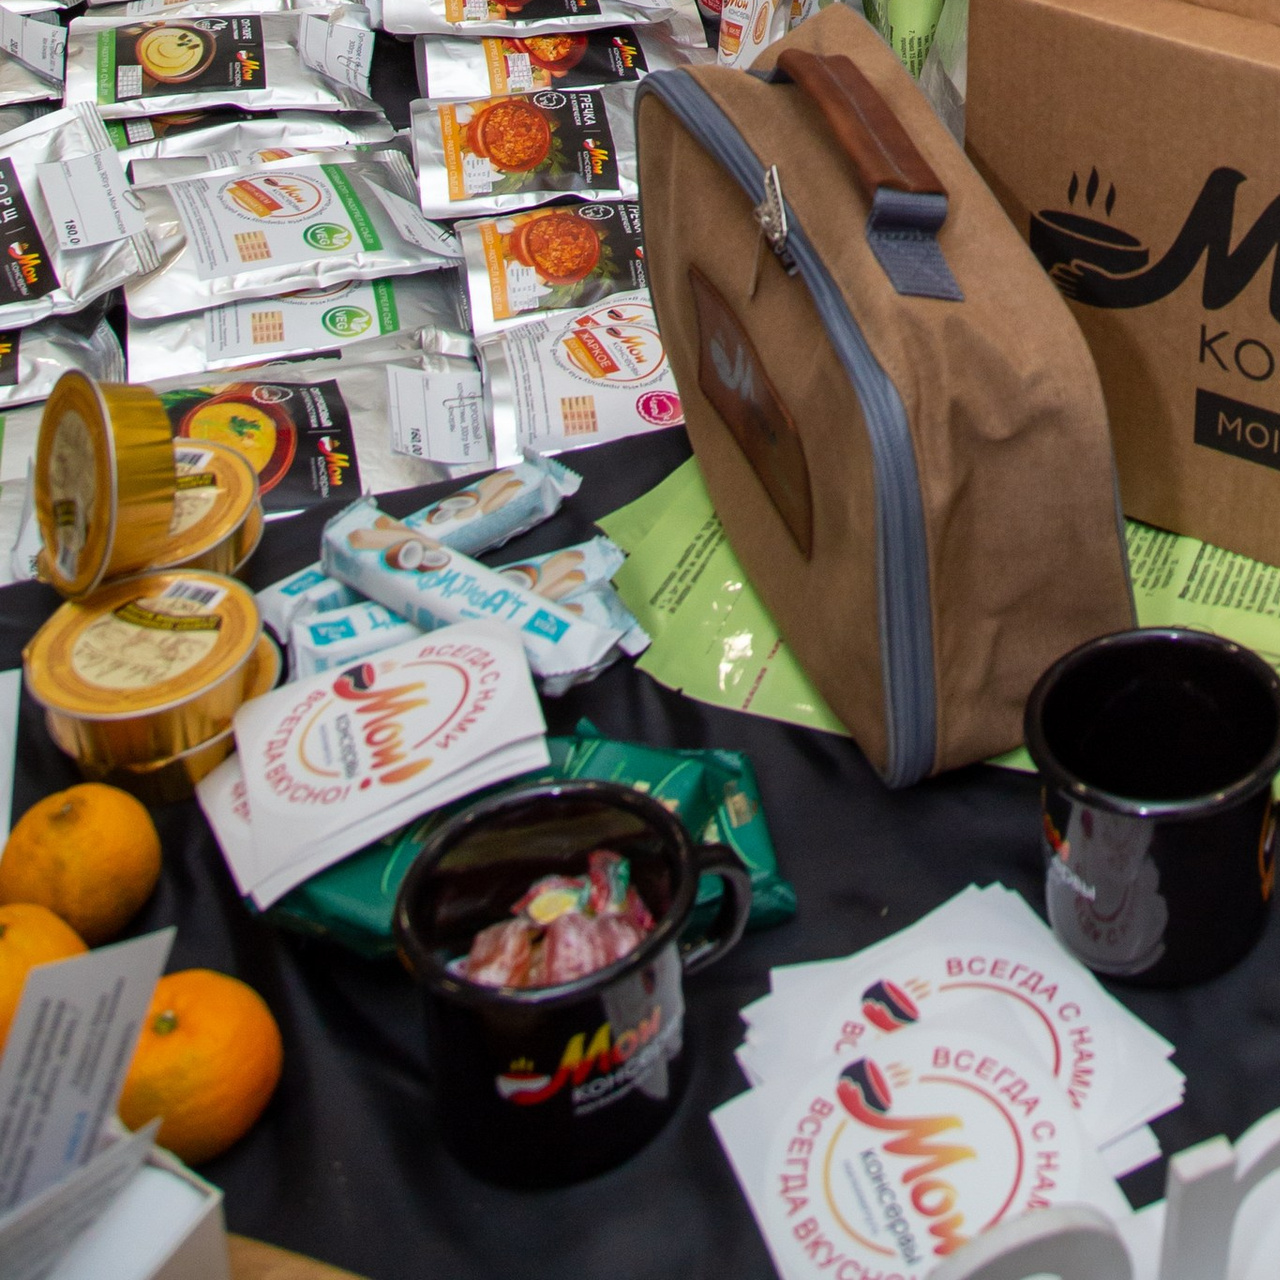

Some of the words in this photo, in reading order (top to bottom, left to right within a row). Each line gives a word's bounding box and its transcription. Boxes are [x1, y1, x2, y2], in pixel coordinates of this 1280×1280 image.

[619, 45, 637, 68] Мои
[578, 93, 597, 126] ГРЕЧКА
[93, 154, 105, 171] Борщ
[582, 151, 593, 183] консервы
[590, 148, 608, 175] Мои
[277, 184, 307, 203] Мои
[314, 227, 329, 245] VEG
[18, 251, 41, 284] Мои
[335, 311, 348, 329] VEG
[580, 332, 613, 369] ЖАРКОЕ
[620, 336, 648, 364] Мои
[324, 451, 350, 486] Мои
[418, 643, 497, 671] ВСЕГДА
[262, 688, 326, 770] ВСЕГДА
[945, 955, 1060, 1004] ВСЕГДА
[1057, 1001, 1082, 1023] С
[1068, 1025, 1096, 1111] НАМИ
[932, 1045, 1042, 1117] ВСЕГДА
[1031, 1120, 1057, 1142] С
[779, 1097, 836, 1217] ВСЕГДА
[859, 1148, 924, 1265] консервы
